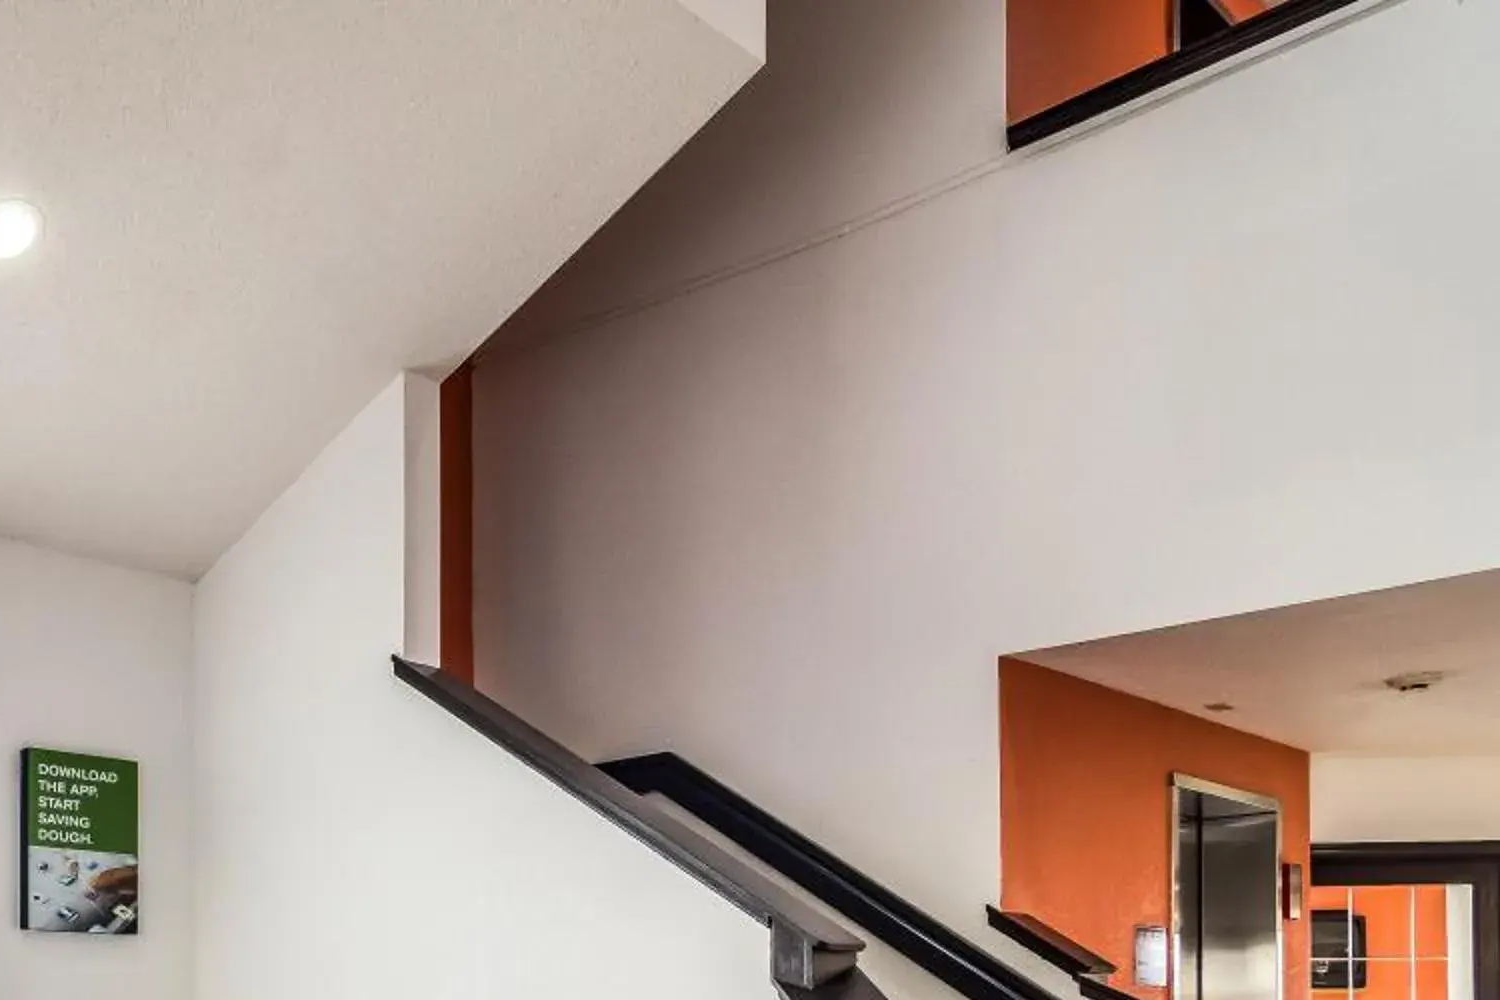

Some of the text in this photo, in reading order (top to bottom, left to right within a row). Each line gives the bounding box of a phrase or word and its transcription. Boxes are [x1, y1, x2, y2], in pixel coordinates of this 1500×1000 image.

[38, 763, 118, 783] DOWNLOAD
[38, 779, 67, 793] THE
[38, 796, 80, 811] START
[38, 812, 91, 829] SAVING
